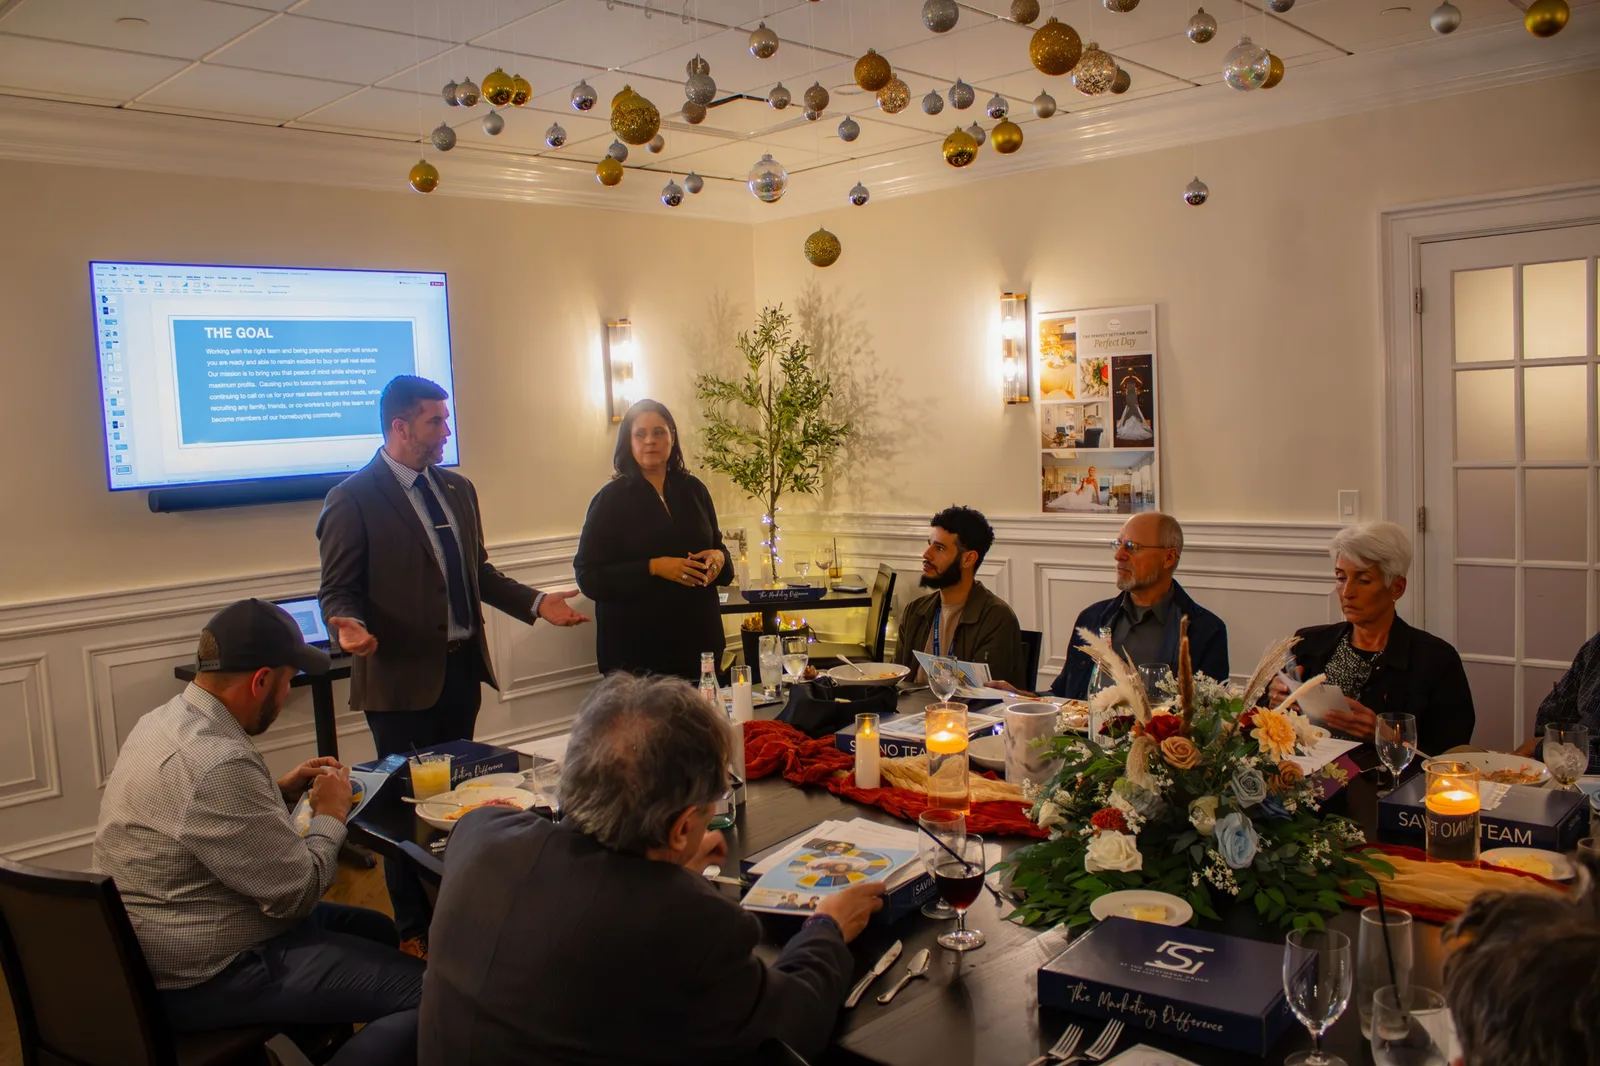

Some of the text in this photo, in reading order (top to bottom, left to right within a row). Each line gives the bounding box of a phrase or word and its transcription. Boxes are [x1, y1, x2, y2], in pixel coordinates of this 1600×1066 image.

[204, 327, 273, 338] THE GOAL
[1094, 337, 1136, 349] Perfect Day
[1067, 982, 1223, 1032] The Marketing Difference
